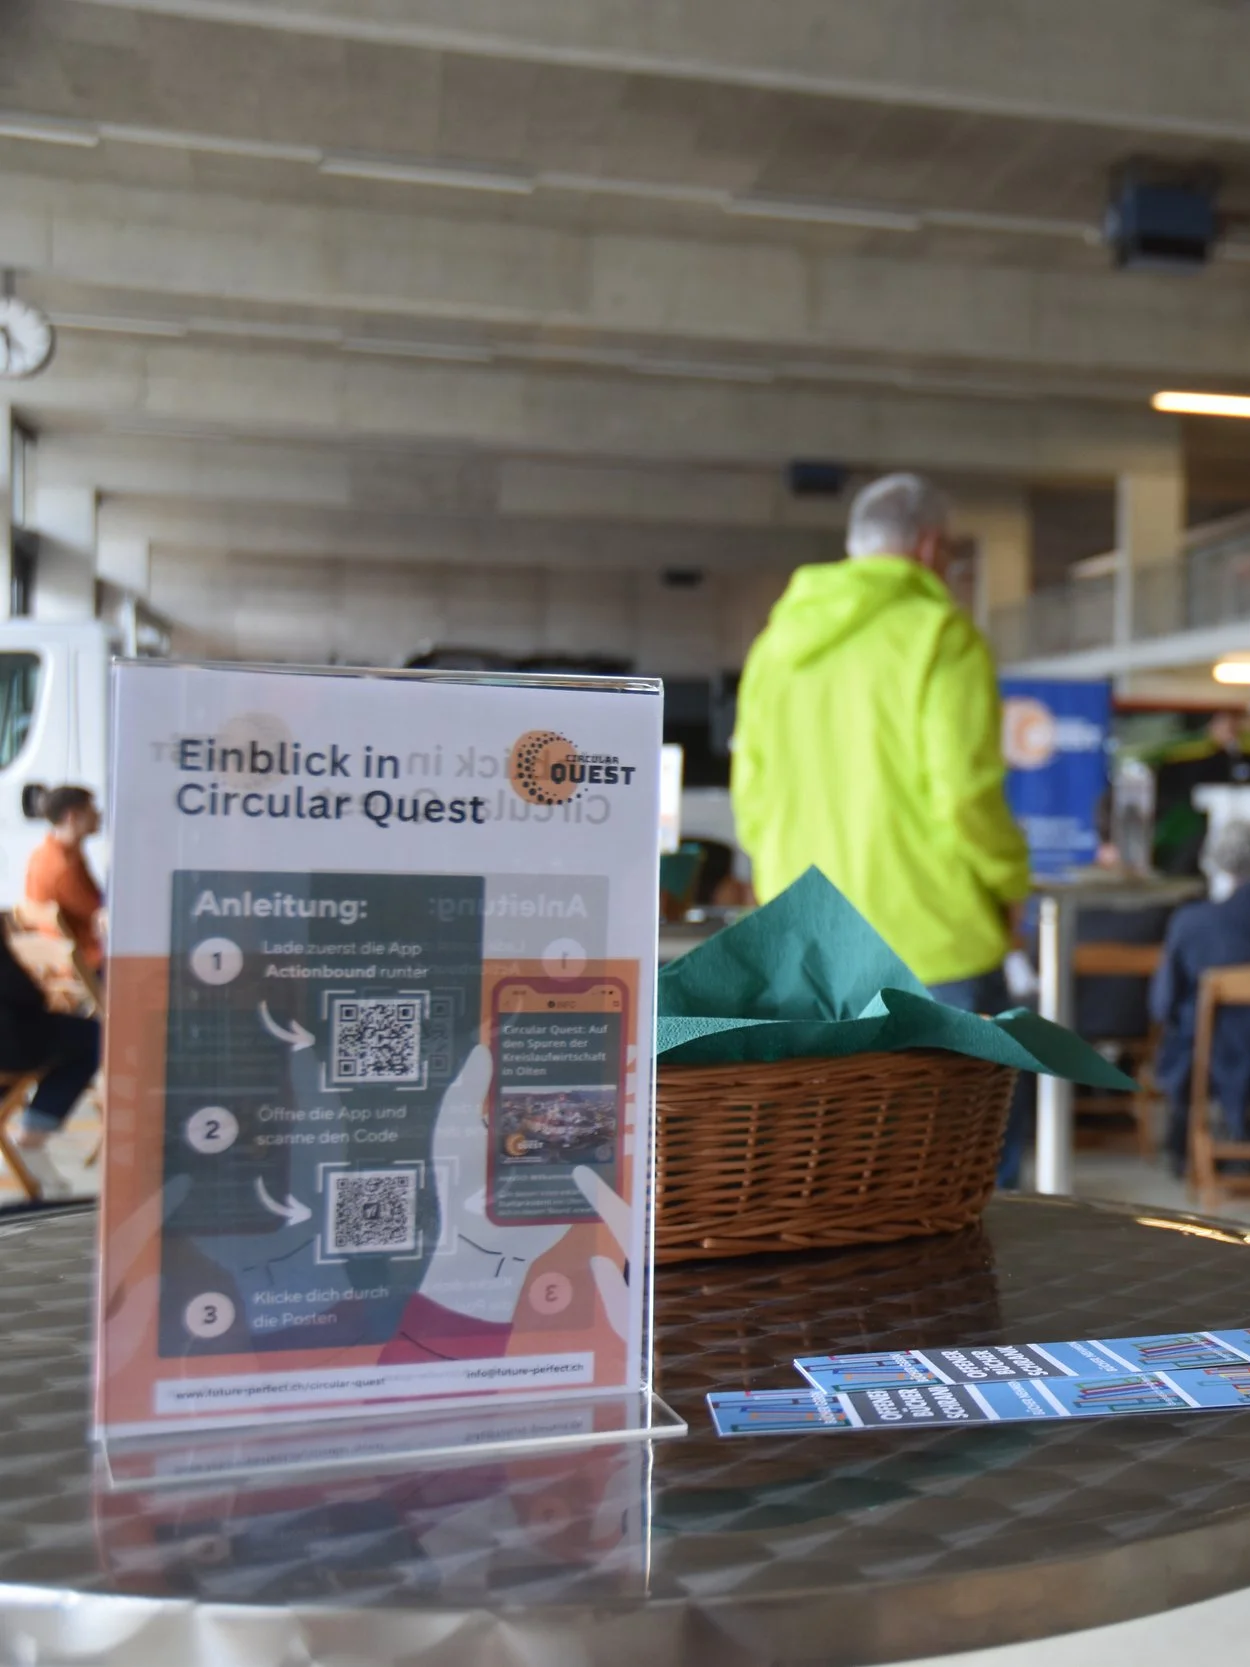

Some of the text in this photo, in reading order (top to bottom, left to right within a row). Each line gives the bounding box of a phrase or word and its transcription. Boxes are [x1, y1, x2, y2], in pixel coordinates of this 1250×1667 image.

[178, 739, 352, 778] Einblick
[364, 745, 400, 779] in
[565, 753, 620, 765] CIRCULAR
[550, 763, 637, 785] QUEST
[175, 782, 352, 820] Circular
[363, 789, 485, 828] Quest
[193, 889, 368, 925] Anleitung:
[262, 940, 301, 955] Lade
[307, 942, 356, 956] zuerst
[359, 941, 385, 955] die
[387, 942, 423, 958] App
[211, 951, 223, 971] 1
[265, 964, 377, 979] Actionbound
[379, 964, 429, 979] runter
[503, 1024, 547, 1035] Circular
[588, 1024, 609, 1034] Auf
[502, 1039, 589, 1050] den Spuren der
[502, 1052, 607, 1062] Kreislaufwirtschaft
[515, 1067, 547, 1076] Olten
[258, 1105, 407, 1122] Öffne die App und
[204, 1120, 221, 1140] 2
[256, 1129, 399, 1146] scanne den Code
[253, 1286, 389, 1305] Klicke dich durch
[203, 1305, 218, 1324] 3
[252, 1311, 338, 1329] die Posten
[940, 1350, 988, 1379] OFFENER
[970, 1350, 1017, 1376] BÜCHER
[993, 1345, 1050, 1376] SCHRANK
[466, 1363, 584, 1379] info@future-perfect.ch
[175, 1376, 387, 1401] www.future-perfect.ch/circular-quest
